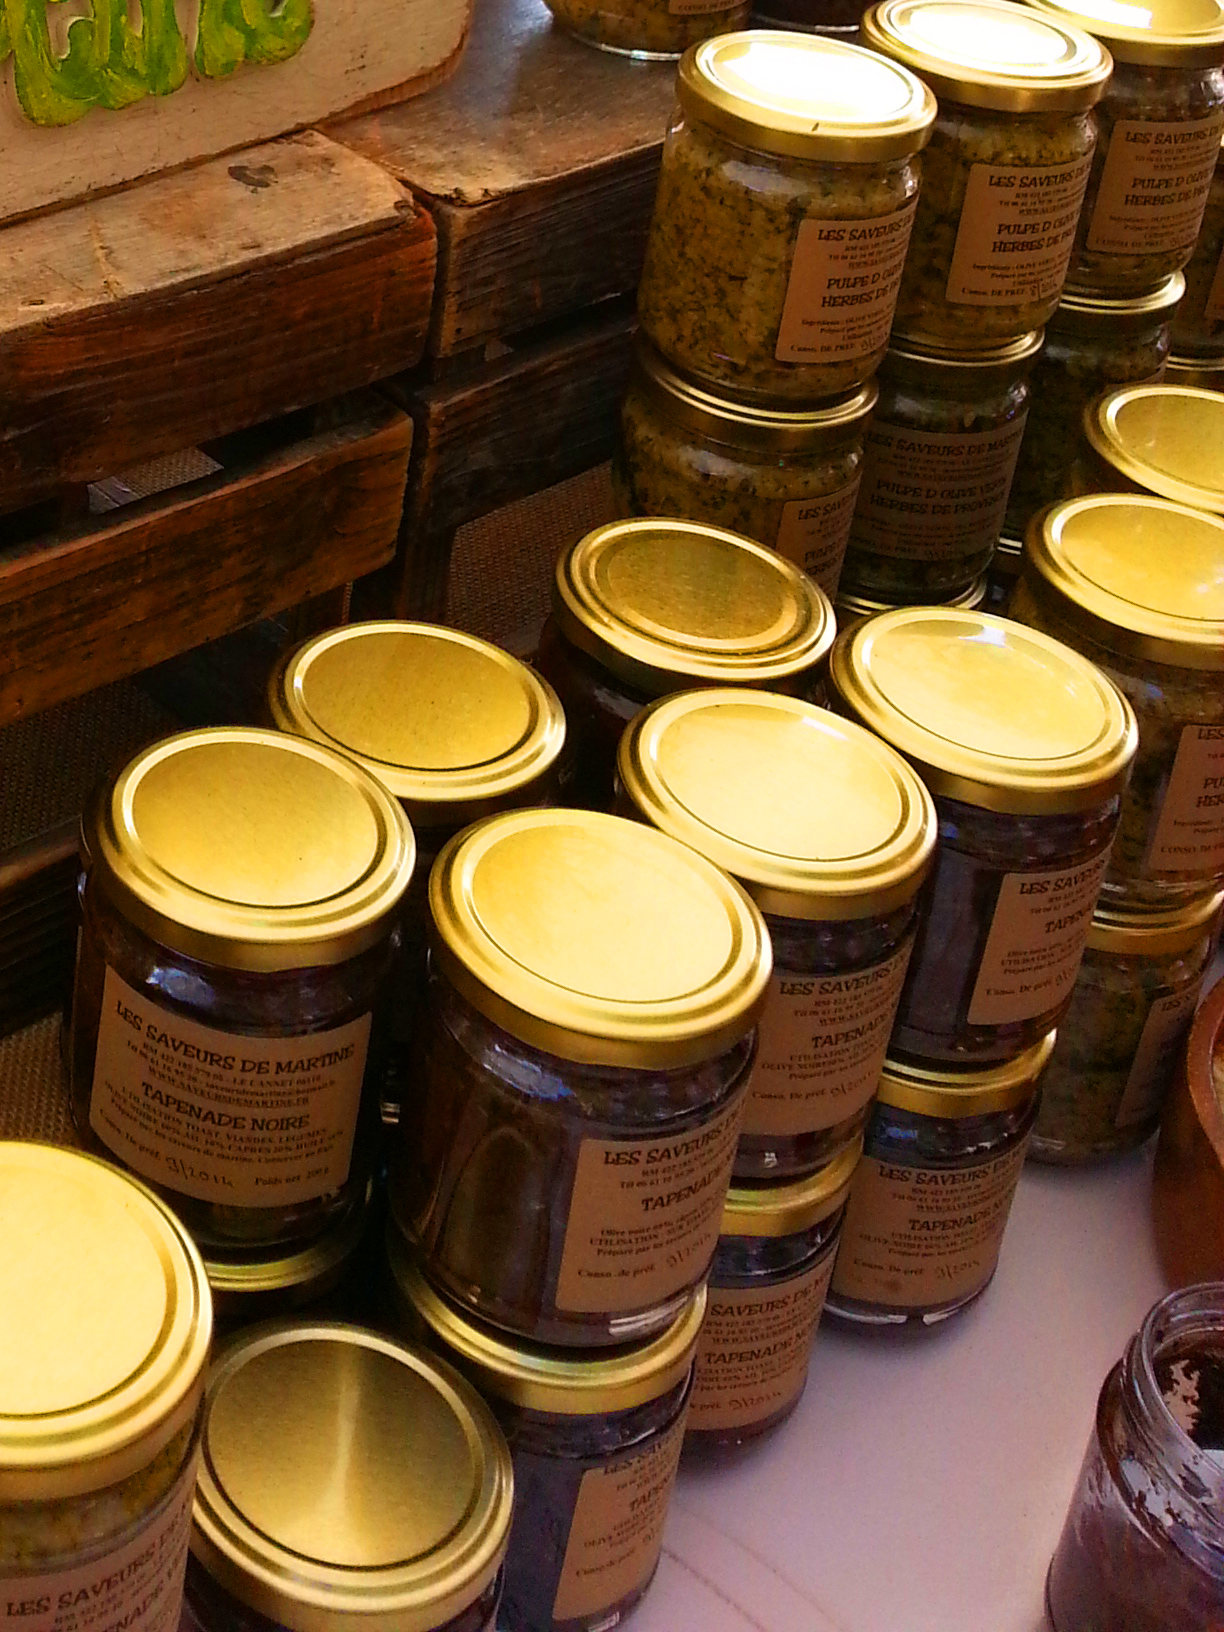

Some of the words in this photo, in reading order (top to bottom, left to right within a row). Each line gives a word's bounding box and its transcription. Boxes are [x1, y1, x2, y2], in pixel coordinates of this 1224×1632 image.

[1124, 131, 1153, 144] LES
[1154, 129, 1207, 145] SAVEURS
[988, 175, 1017, 188] LES
[1018, 168, 1075, 188] SAVEURS
[1132, 177, 1174, 189] PULPE
[1124, 192, 1176, 206] HERBES
[817, 228, 846, 241] LES
[848, 221, 903, 241] SAVEURS
[997, 222, 1040, 235] PULPE
[1041, 220, 1052, 232] D
[991, 237, 1045, 253] HERBES
[826, 275, 870, 290] PULPE
[871, 272, 881, 285] D
[821, 289, 874, 308] HERBES
[896, 438, 965, 456] SAVEURS
[967, 443, 986, 456] DE
[876, 479, 923, 498] PULPE
[926, 488, 938, 499] D
[940, 487, 978, 499] OLIVE
[870, 493, 929, 515] HERBES
[931, 503, 952, 515] DE
[1019, 880, 1051, 895] LES
[779, 981, 815, 996] LES
[818, 968, 891, 995] SAVEURS
[116, 999, 143, 1032] LES
[145, 1024, 236, 1071] SAVEURS
[240, 1058, 270, 1075] DE
[274, 1043, 356, 1075] MARTINE
[141, 1081, 247, 1130] TAPENADE
[251, 1114, 311, 1132] NOIRE
[604, 1150, 642, 1165] LES
[645, 1123, 723, 1165] SAVEURS
[879, 1164, 913, 1183] LES
[915, 1167, 990, 1187] SAVEURS
[710, 1294, 791, 1318] SAVEURS
[704, 1335, 794, 1364] TAPENADE
[6, 1595, 51, 1617] LES
[56, 1540, 157, 1610] SAVEURS
